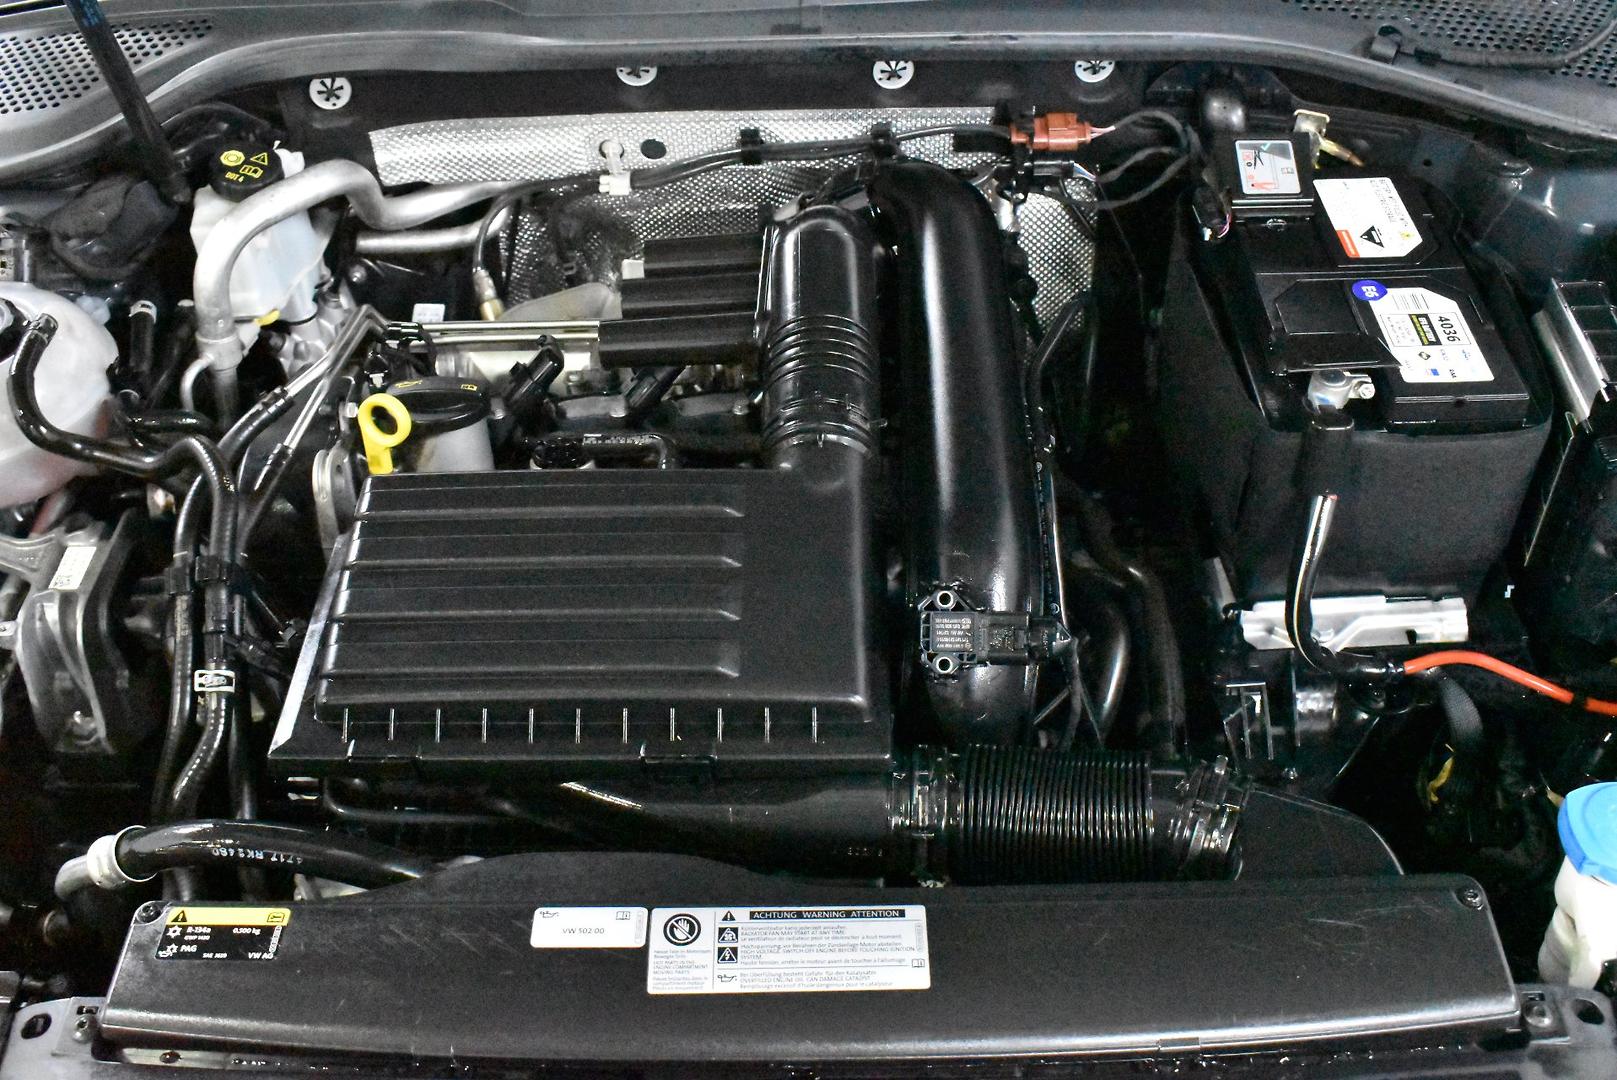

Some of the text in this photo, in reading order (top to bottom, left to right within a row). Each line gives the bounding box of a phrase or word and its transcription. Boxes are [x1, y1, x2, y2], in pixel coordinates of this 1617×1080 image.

[1438, 315, 1461, 342] 4036
[753, 910, 900, 919] ACHTUNG WARNING ATTENTION
[186, 926, 212, 934] R-134a
[252, 927, 261, 936] kg
[180, 944, 198, 952] PAG
